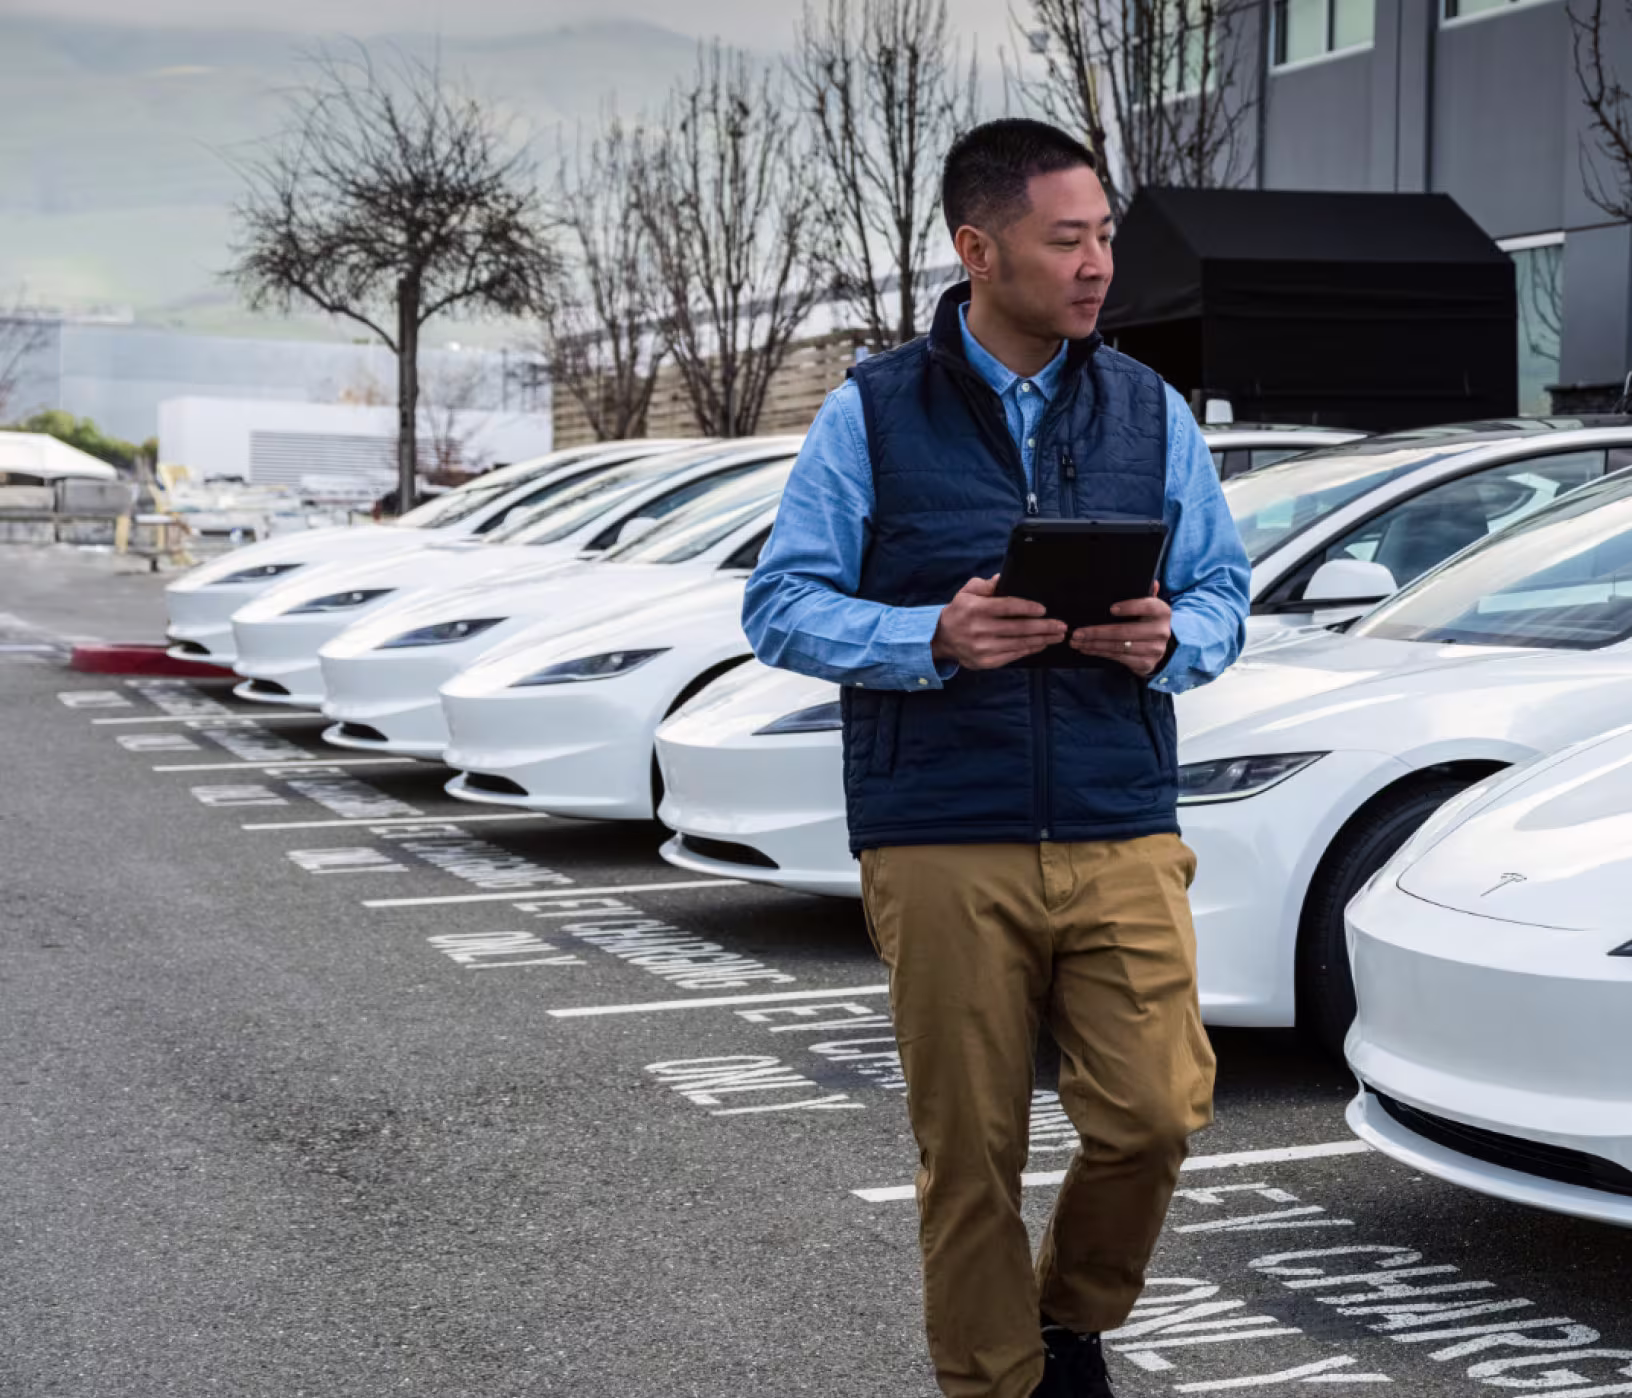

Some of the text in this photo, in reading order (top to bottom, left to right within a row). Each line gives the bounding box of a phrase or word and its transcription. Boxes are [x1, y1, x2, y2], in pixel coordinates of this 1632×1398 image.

[427, 931, 588, 969] ONLY
[512, 899, 797, 989] EV CHARGING
[733, 1002, 893, 1032] EV
[644, 1056, 866, 1116] ONLY
[1172, 1183, 1356, 1233] EV
